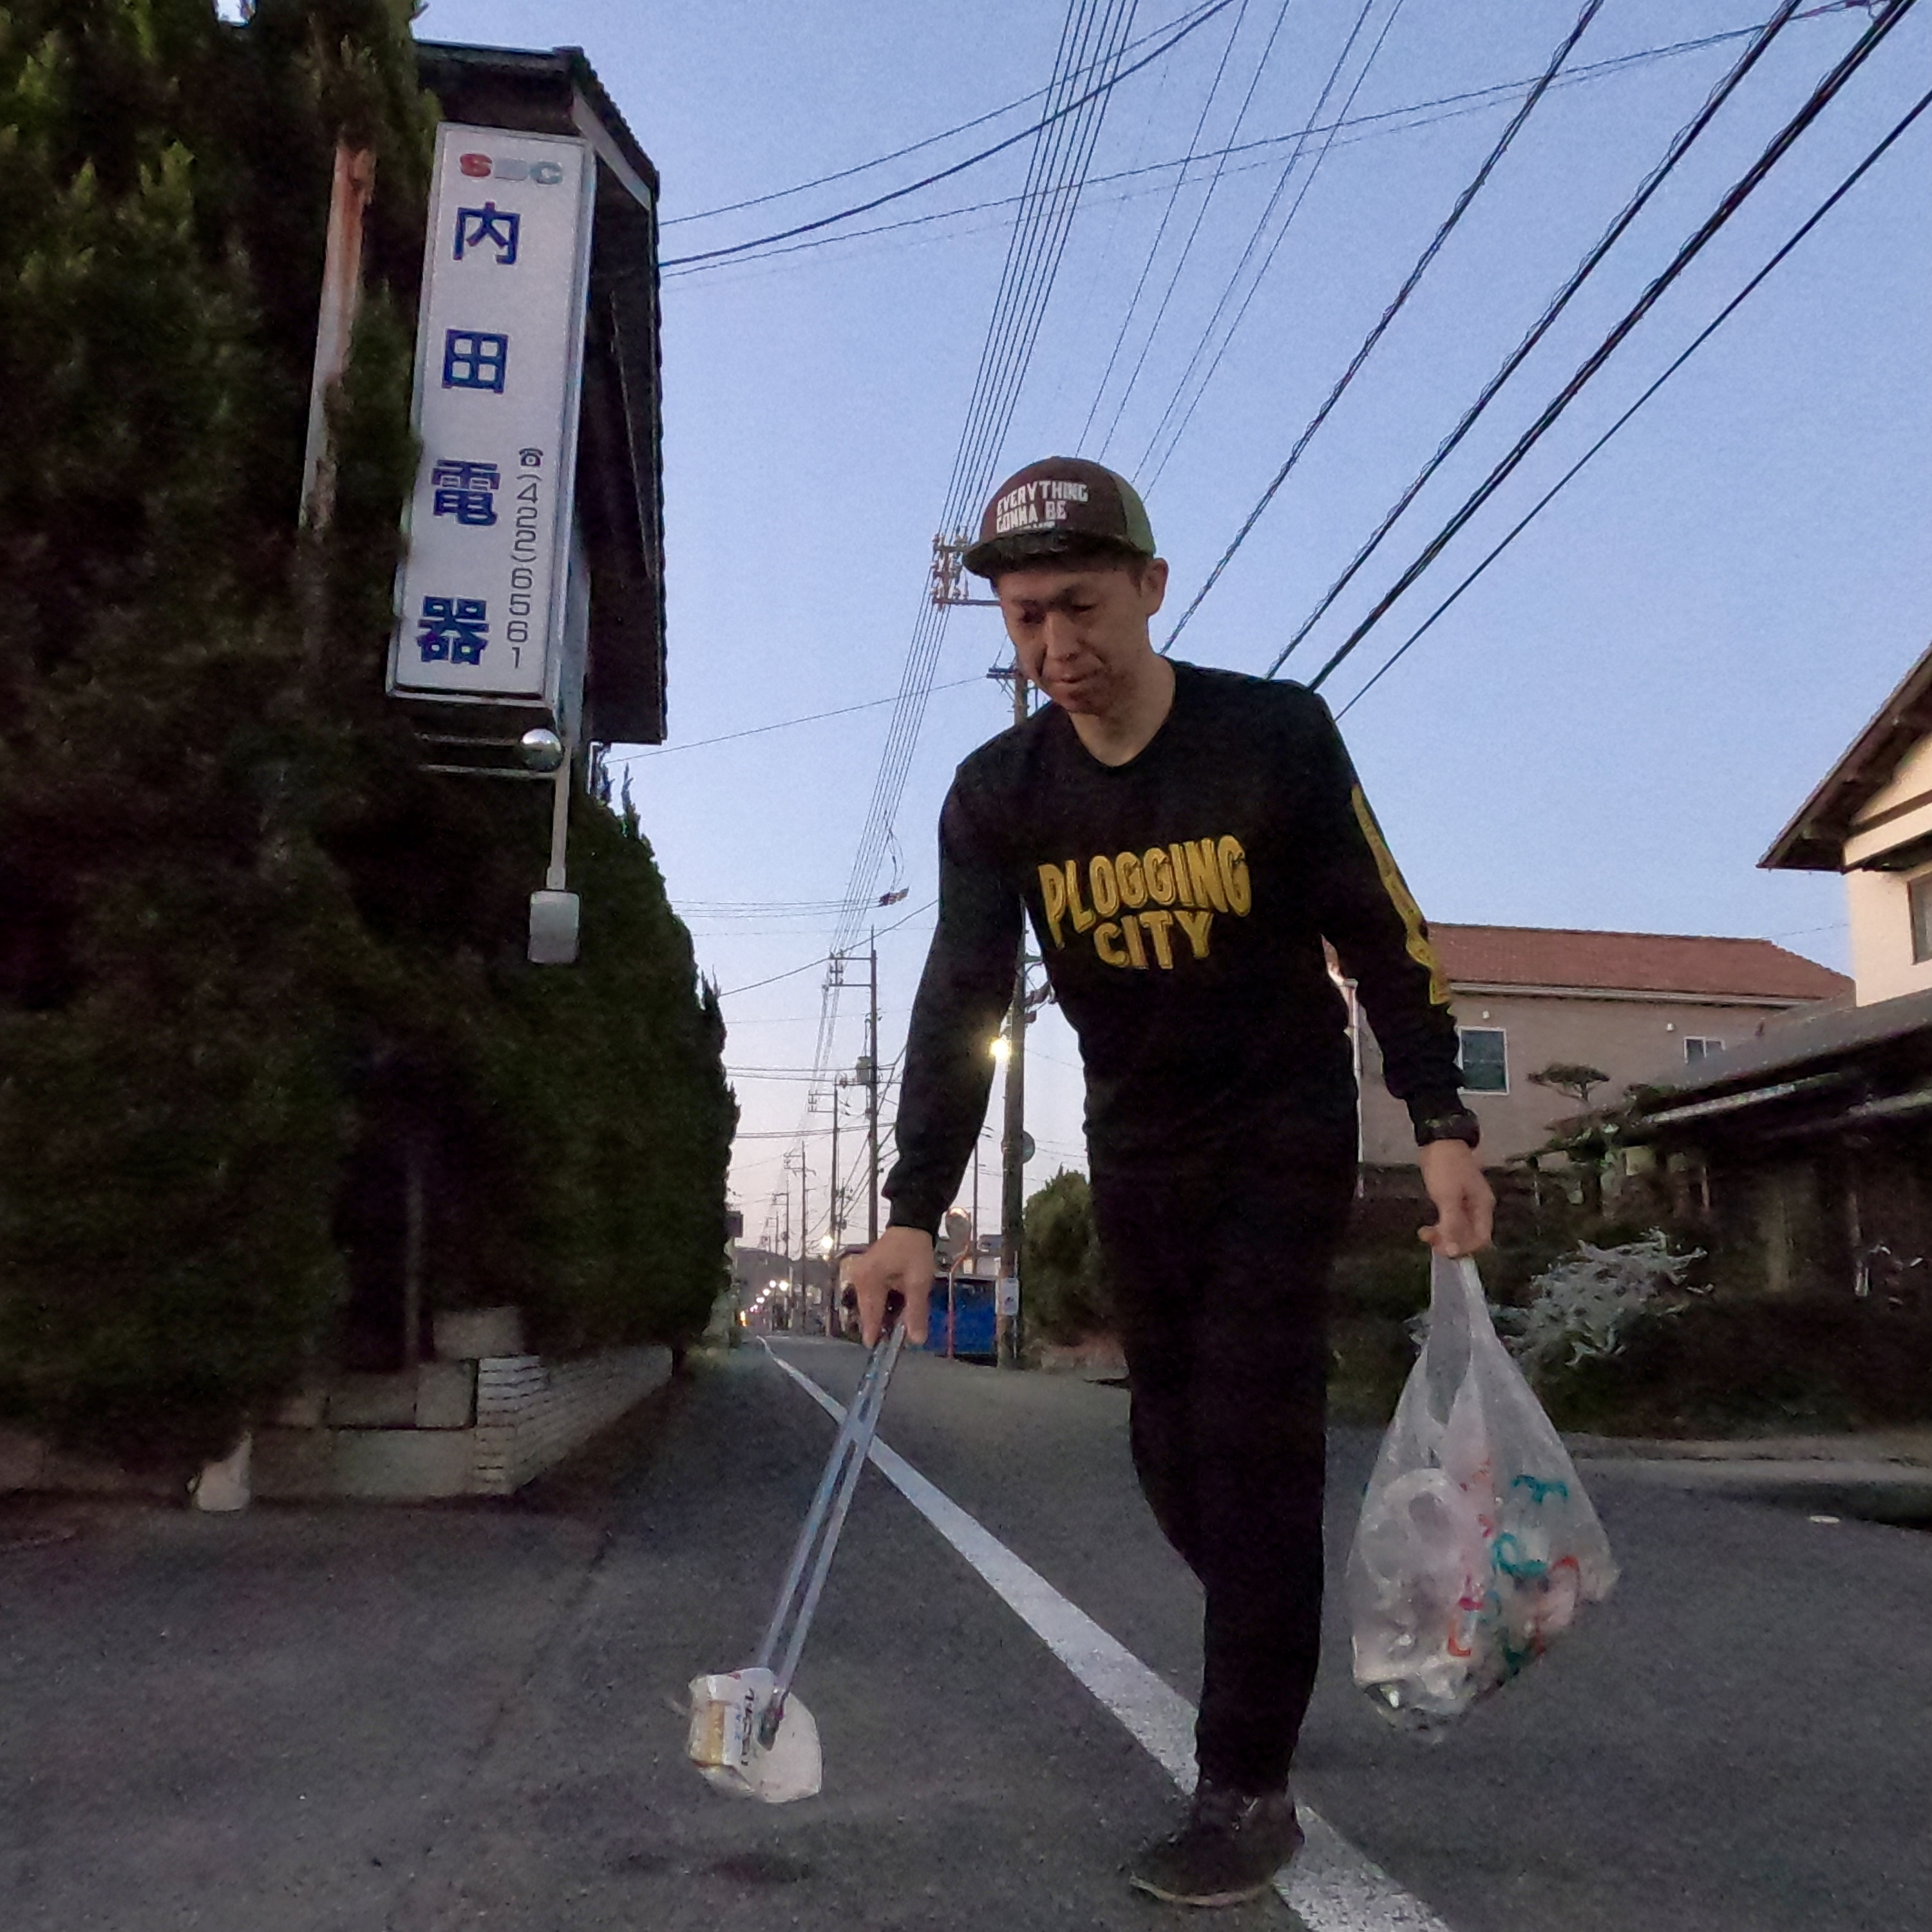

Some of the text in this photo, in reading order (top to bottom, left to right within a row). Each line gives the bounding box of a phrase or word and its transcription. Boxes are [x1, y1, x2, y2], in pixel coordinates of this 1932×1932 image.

[416, 201, 521, 666] 内田電器
[996, 480, 1089, 516] EVERYTHING
[996, 500, 1067, 533] GONNA BE
[1037, 834, 1251, 951] PLOGGING
[1094, 910, 1214, 970] CITY
